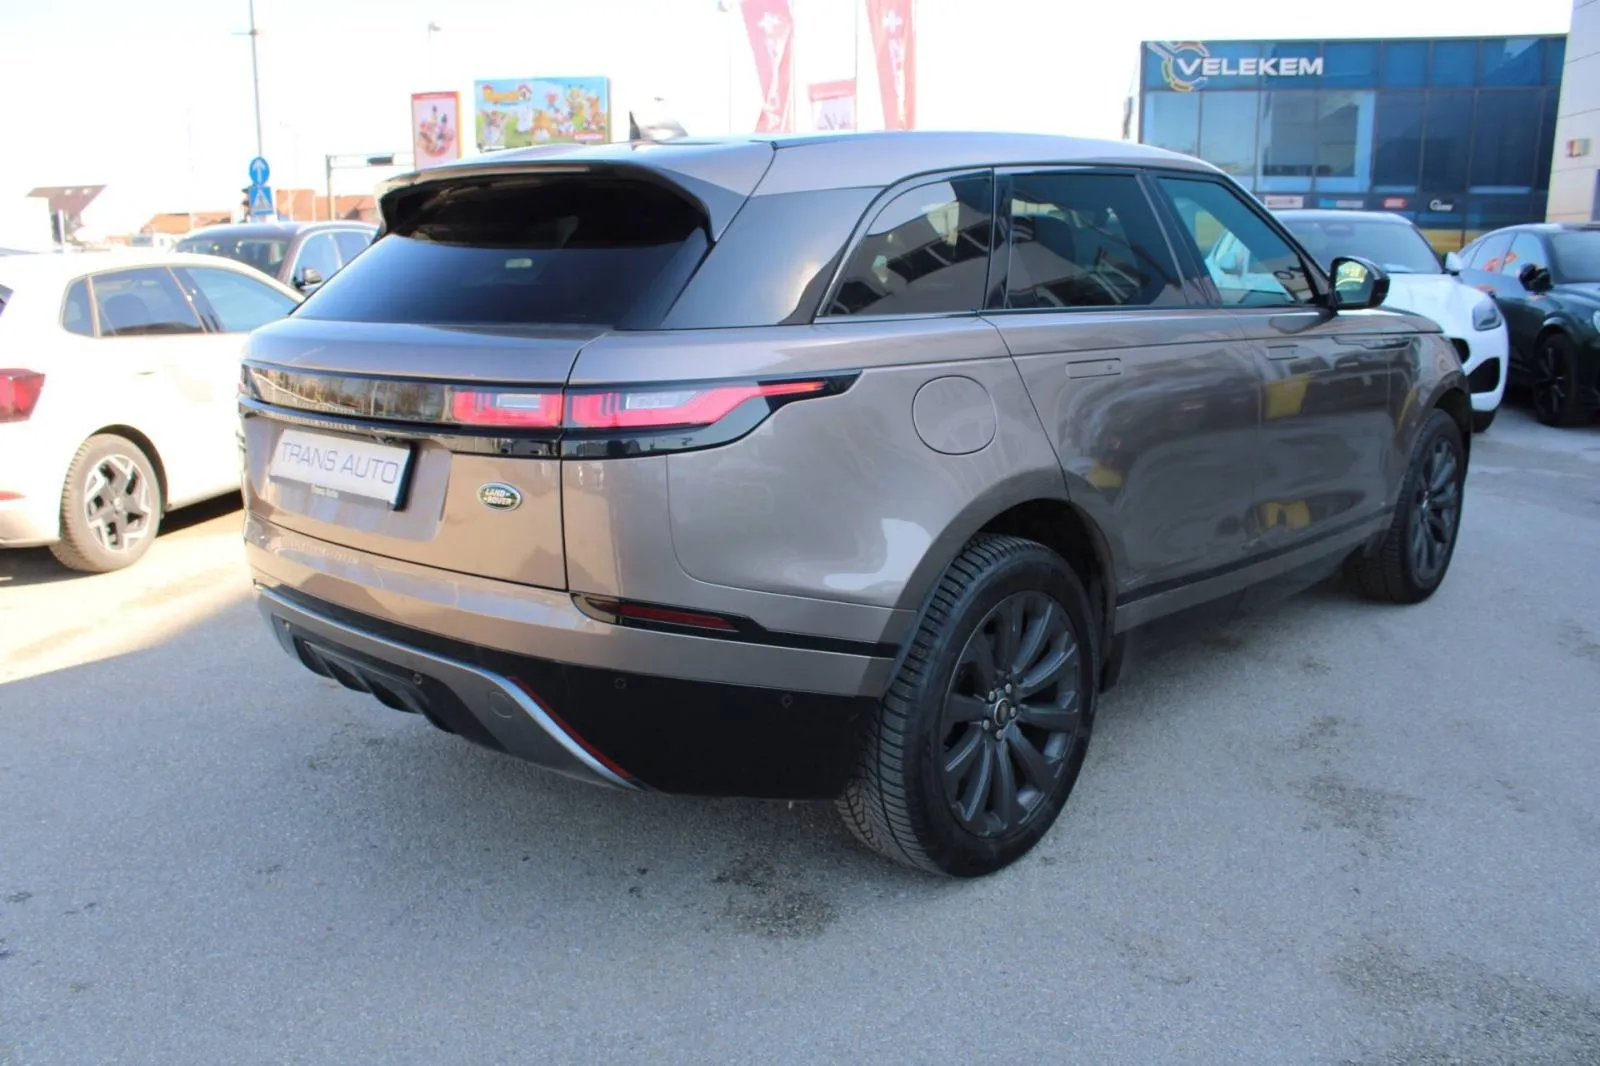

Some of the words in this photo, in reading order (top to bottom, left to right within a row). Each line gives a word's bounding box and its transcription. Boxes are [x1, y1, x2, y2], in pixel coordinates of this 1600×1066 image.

[1176, 57, 1323, 76] VELEKEM
[282, 442, 336, 471] TRANS
[340, 455, 398, 484] AUTO
[484, 488, 506, 497] LAND
[487, 496, 512, 506] ROVER
